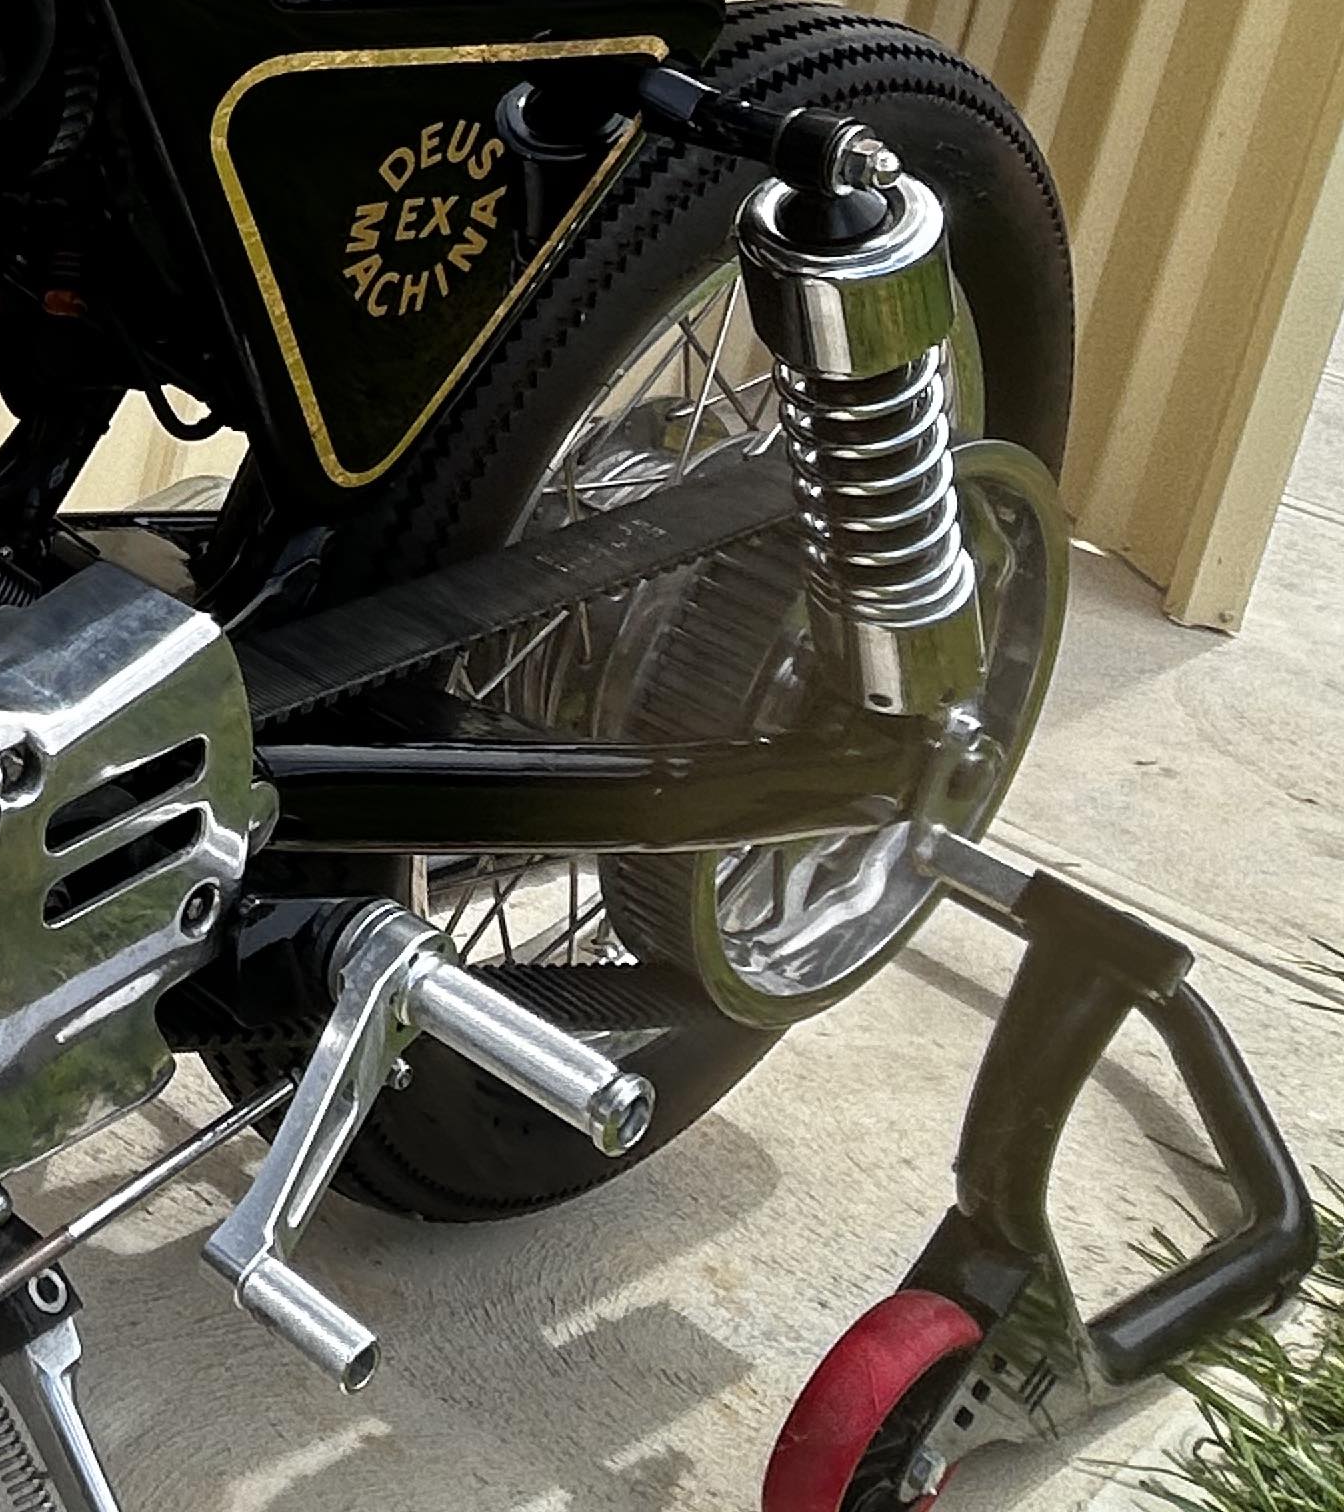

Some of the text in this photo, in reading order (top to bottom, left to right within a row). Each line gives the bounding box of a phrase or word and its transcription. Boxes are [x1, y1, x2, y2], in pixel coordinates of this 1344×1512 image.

[379, 119, 505, 192] DEUS
[343, 186, 508, 317] MACHINA
[395, 196, 459, 241] EX
